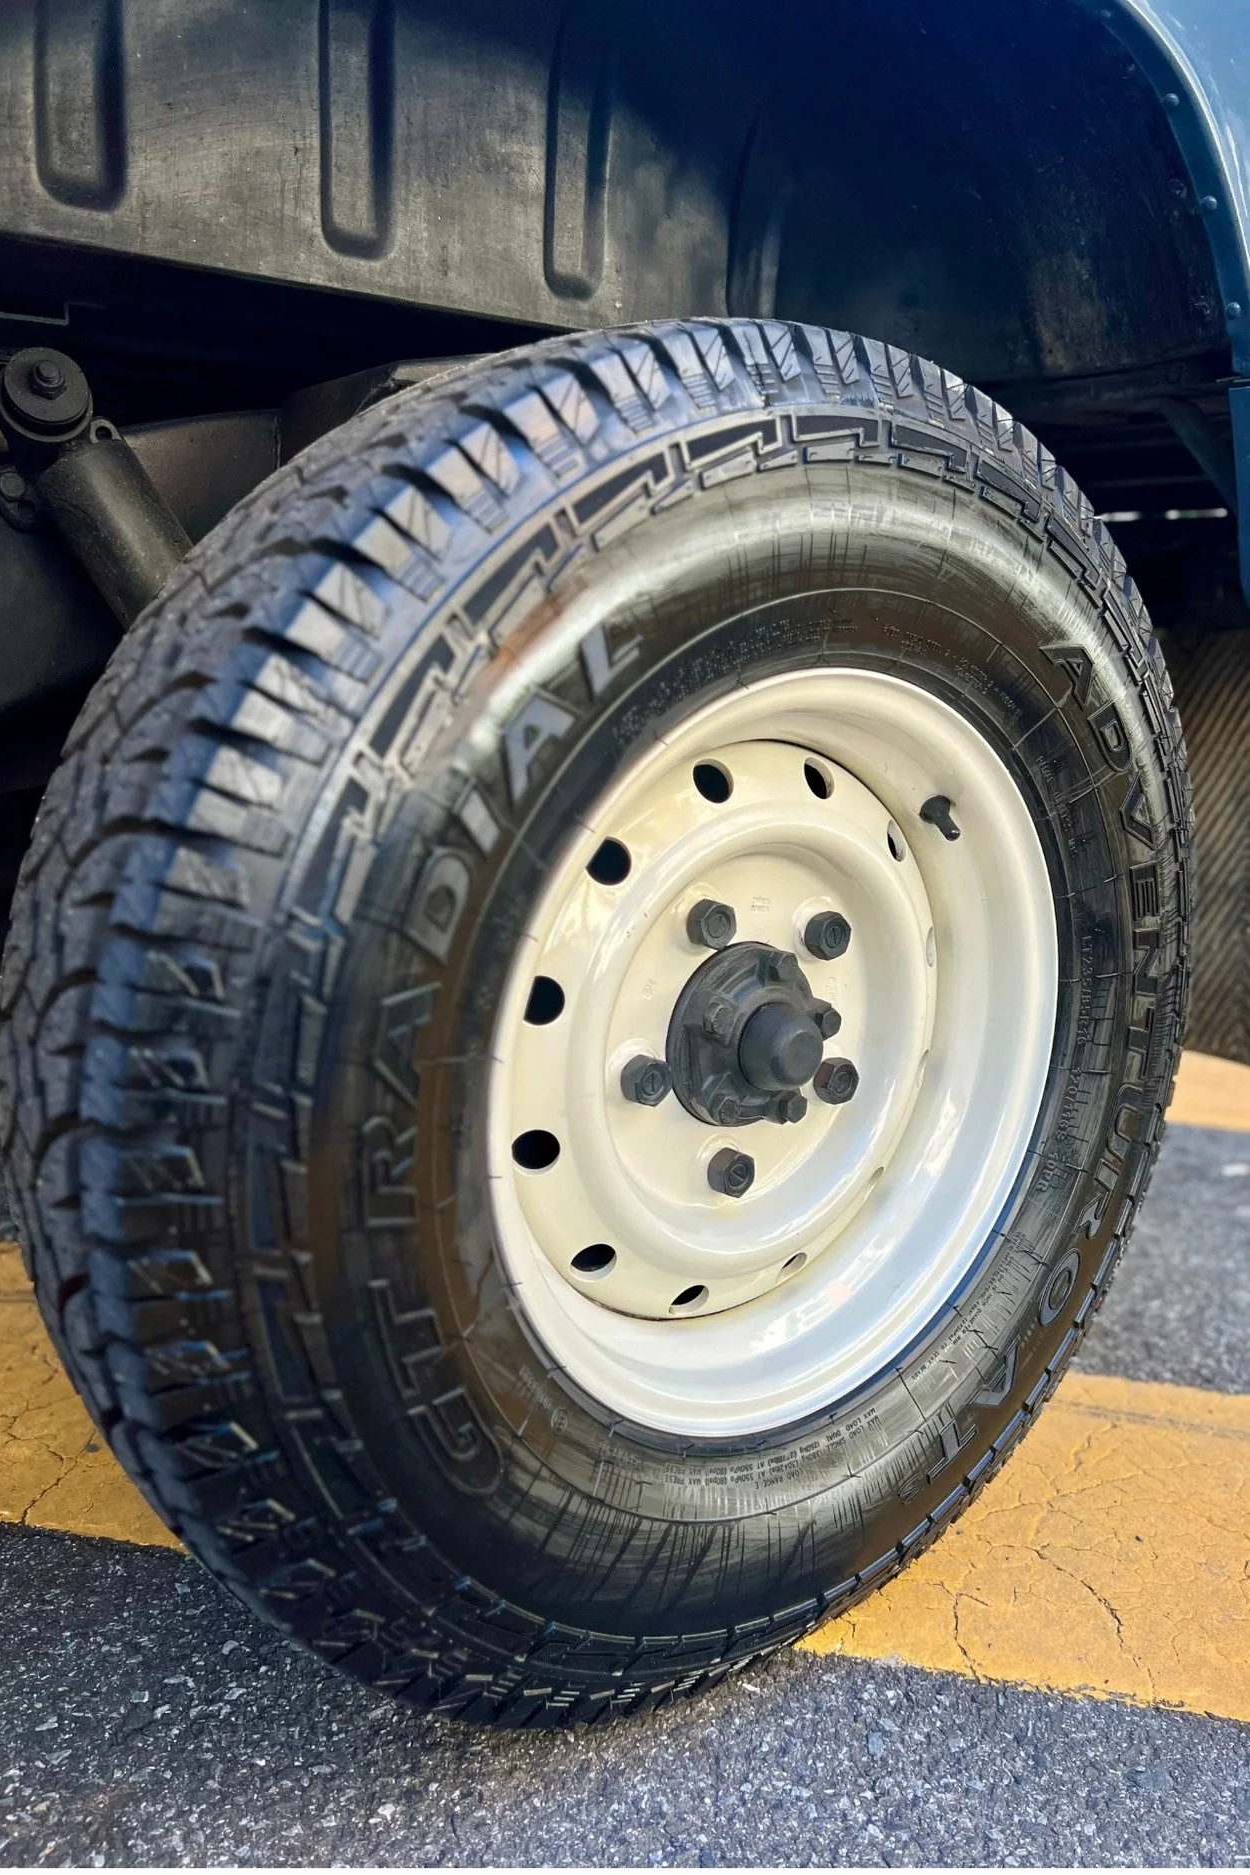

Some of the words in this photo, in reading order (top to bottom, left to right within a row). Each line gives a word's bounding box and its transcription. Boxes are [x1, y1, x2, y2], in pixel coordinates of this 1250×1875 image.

[362, 624, 644, 1227] RADIAL
[1038, 643, 1161, 1327] ADVENTURO
[1077, 935, 1093, 1046] LT235/85R16
[980, 1291, 992, 1308] INCH
[960, 1306, 982, 1335] DIAMETER
[951, 1334, 961, 1347] RIM
[367, 1278, 504, 1496] GT
[862, 1406, 876, 1421] MAX
[844, 1416, 861, 1432] LOAD
[866, 1414, 879, 1429] MAX
[824, 1428, 841, 1442] DUAL
[847, 1424, 864, 1440] LOAD
[825, 1435, 846, 1452] SINGLE
[728, 1462, 753, 1473] 550kPa
[785, 1466, 803, 1480] LOAD
[663, 1473, 685, 1485] PRESS
[687, 1477, 702, 1485] MAX
[703, 1475, 727, 1485] (80psi)
[729, 1471, 754, 1483] 550kPa
[753, 1480, 759, 1489] E
[762, 1474, 783, 1488] RANGE
